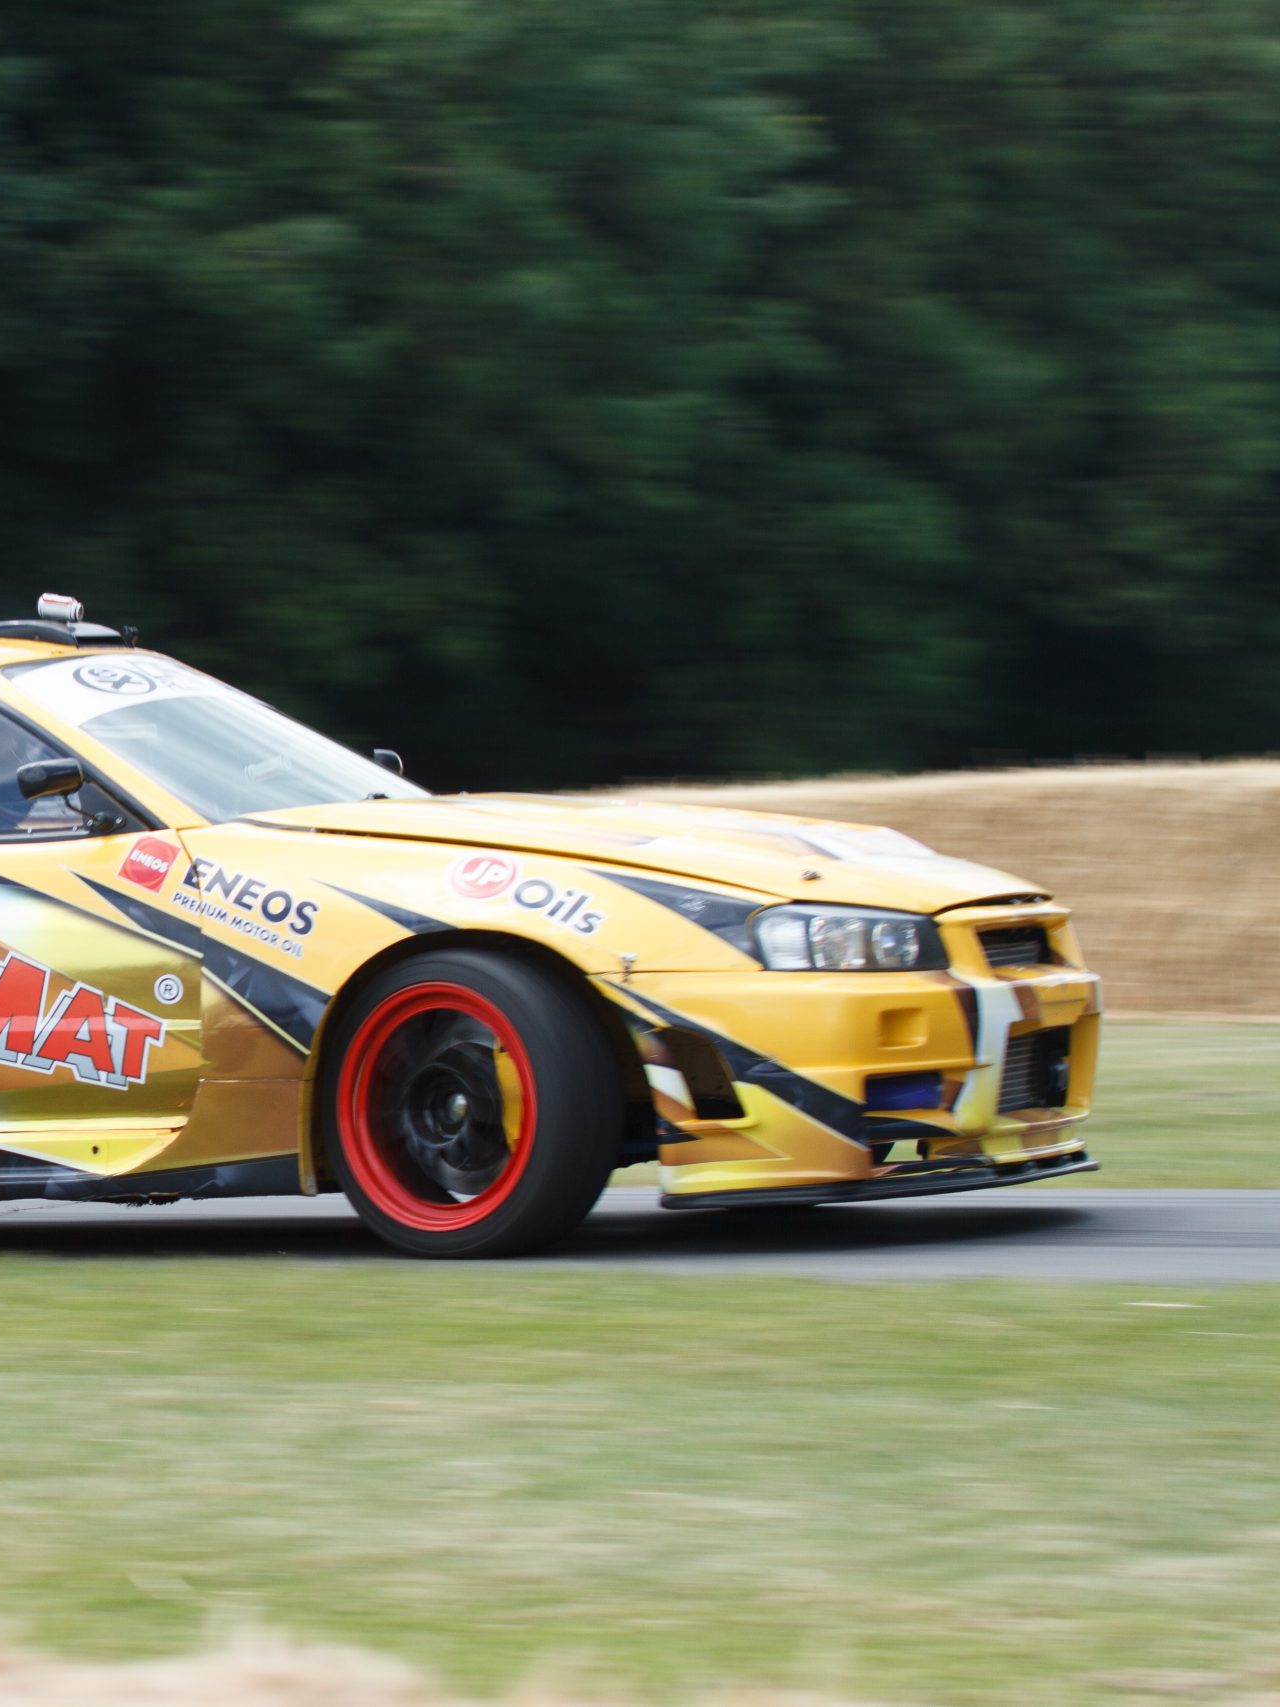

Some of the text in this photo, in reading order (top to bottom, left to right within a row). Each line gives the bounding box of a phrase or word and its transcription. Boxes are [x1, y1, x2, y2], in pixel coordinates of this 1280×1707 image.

[130, 849, 169, 873] ENEOS
[183, 857, 319, 935] ENEOS
[514, 879, 602, 934] Oils
[230, 915, 278, 946] MOTOR
[282, 938, 304, 959] OIL
